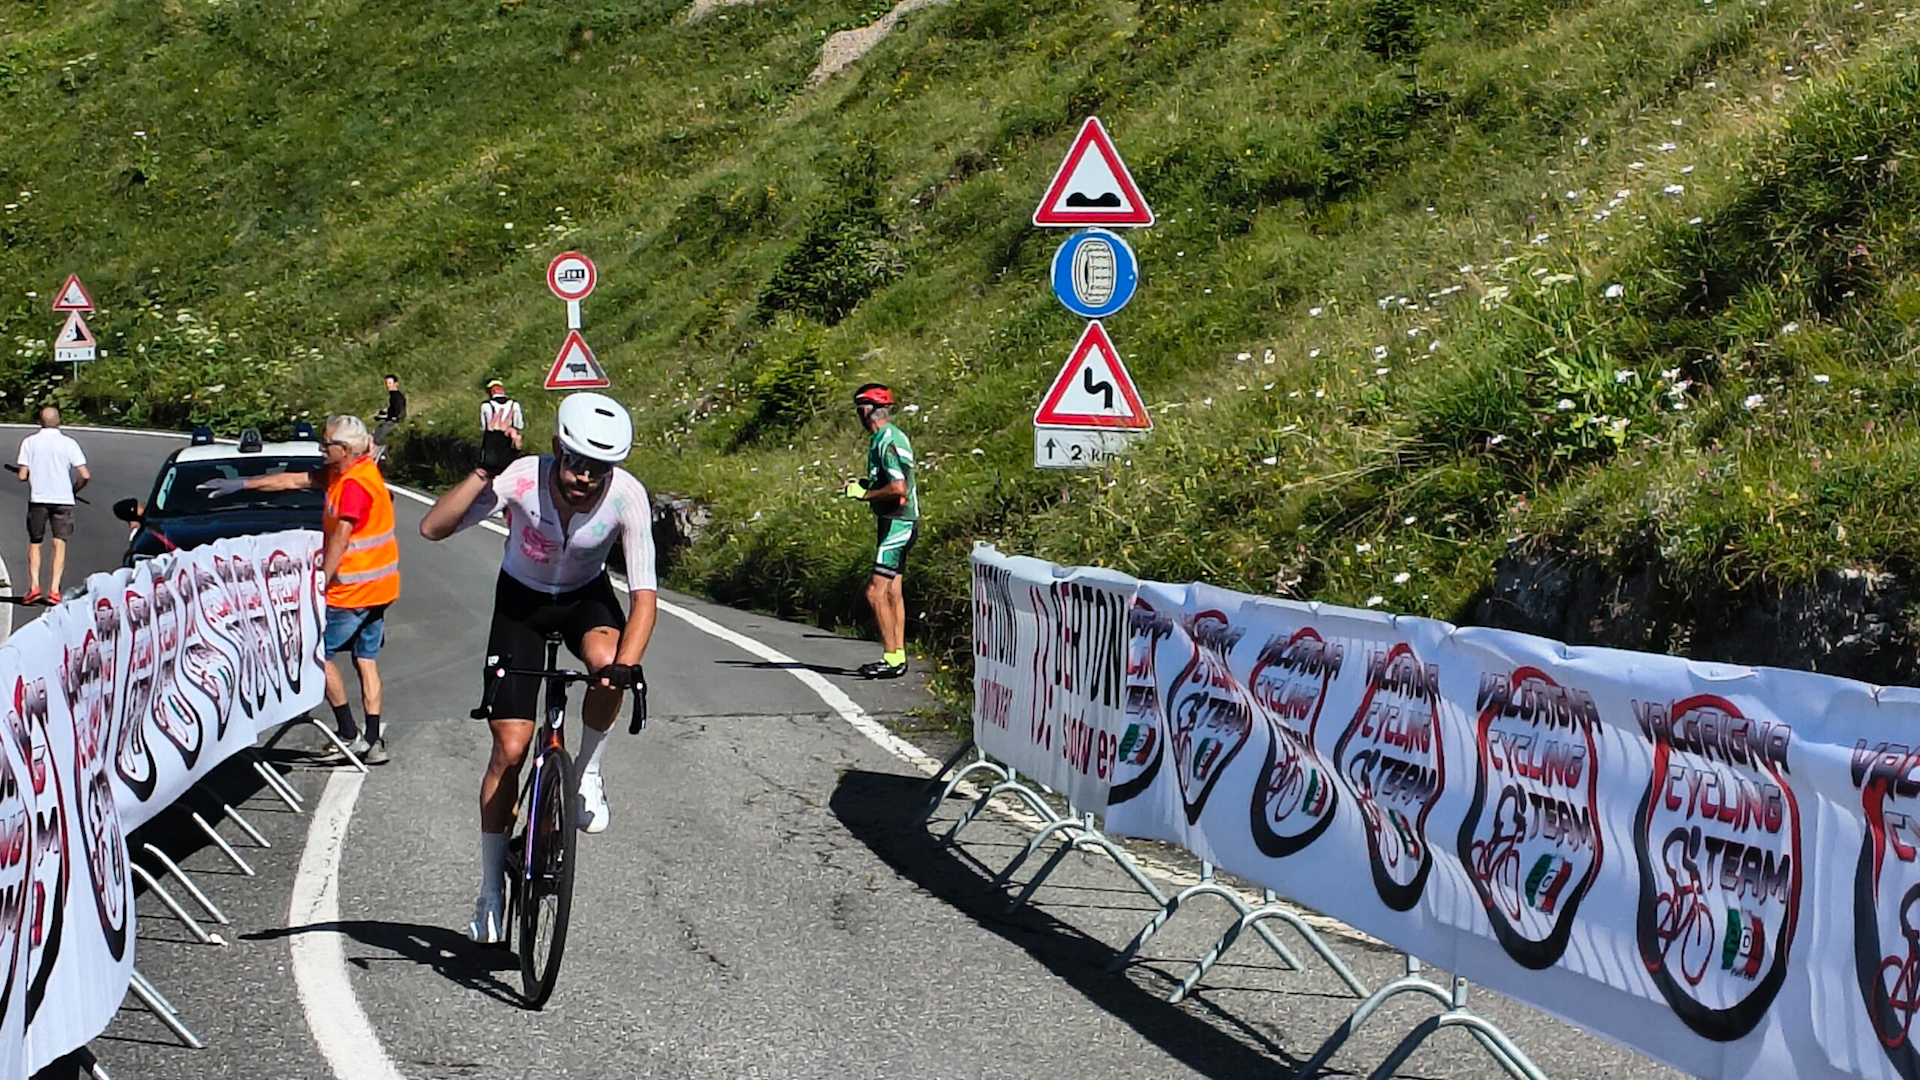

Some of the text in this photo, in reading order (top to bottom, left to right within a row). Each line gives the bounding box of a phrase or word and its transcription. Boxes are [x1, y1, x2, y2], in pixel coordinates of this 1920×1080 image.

[1071, 445, 1082, 460] 2
[1362, 702, 1431, 754] CYCLING
[1374, 755, 1437, 806] TEAM
[1489, 729, 1585, 787] CYCLING
[1528, 792, 1595, 852] TEAM
[1665, 764, 1783, 833] CYCLING
[1705, 836, 1790, 905] TEAM
